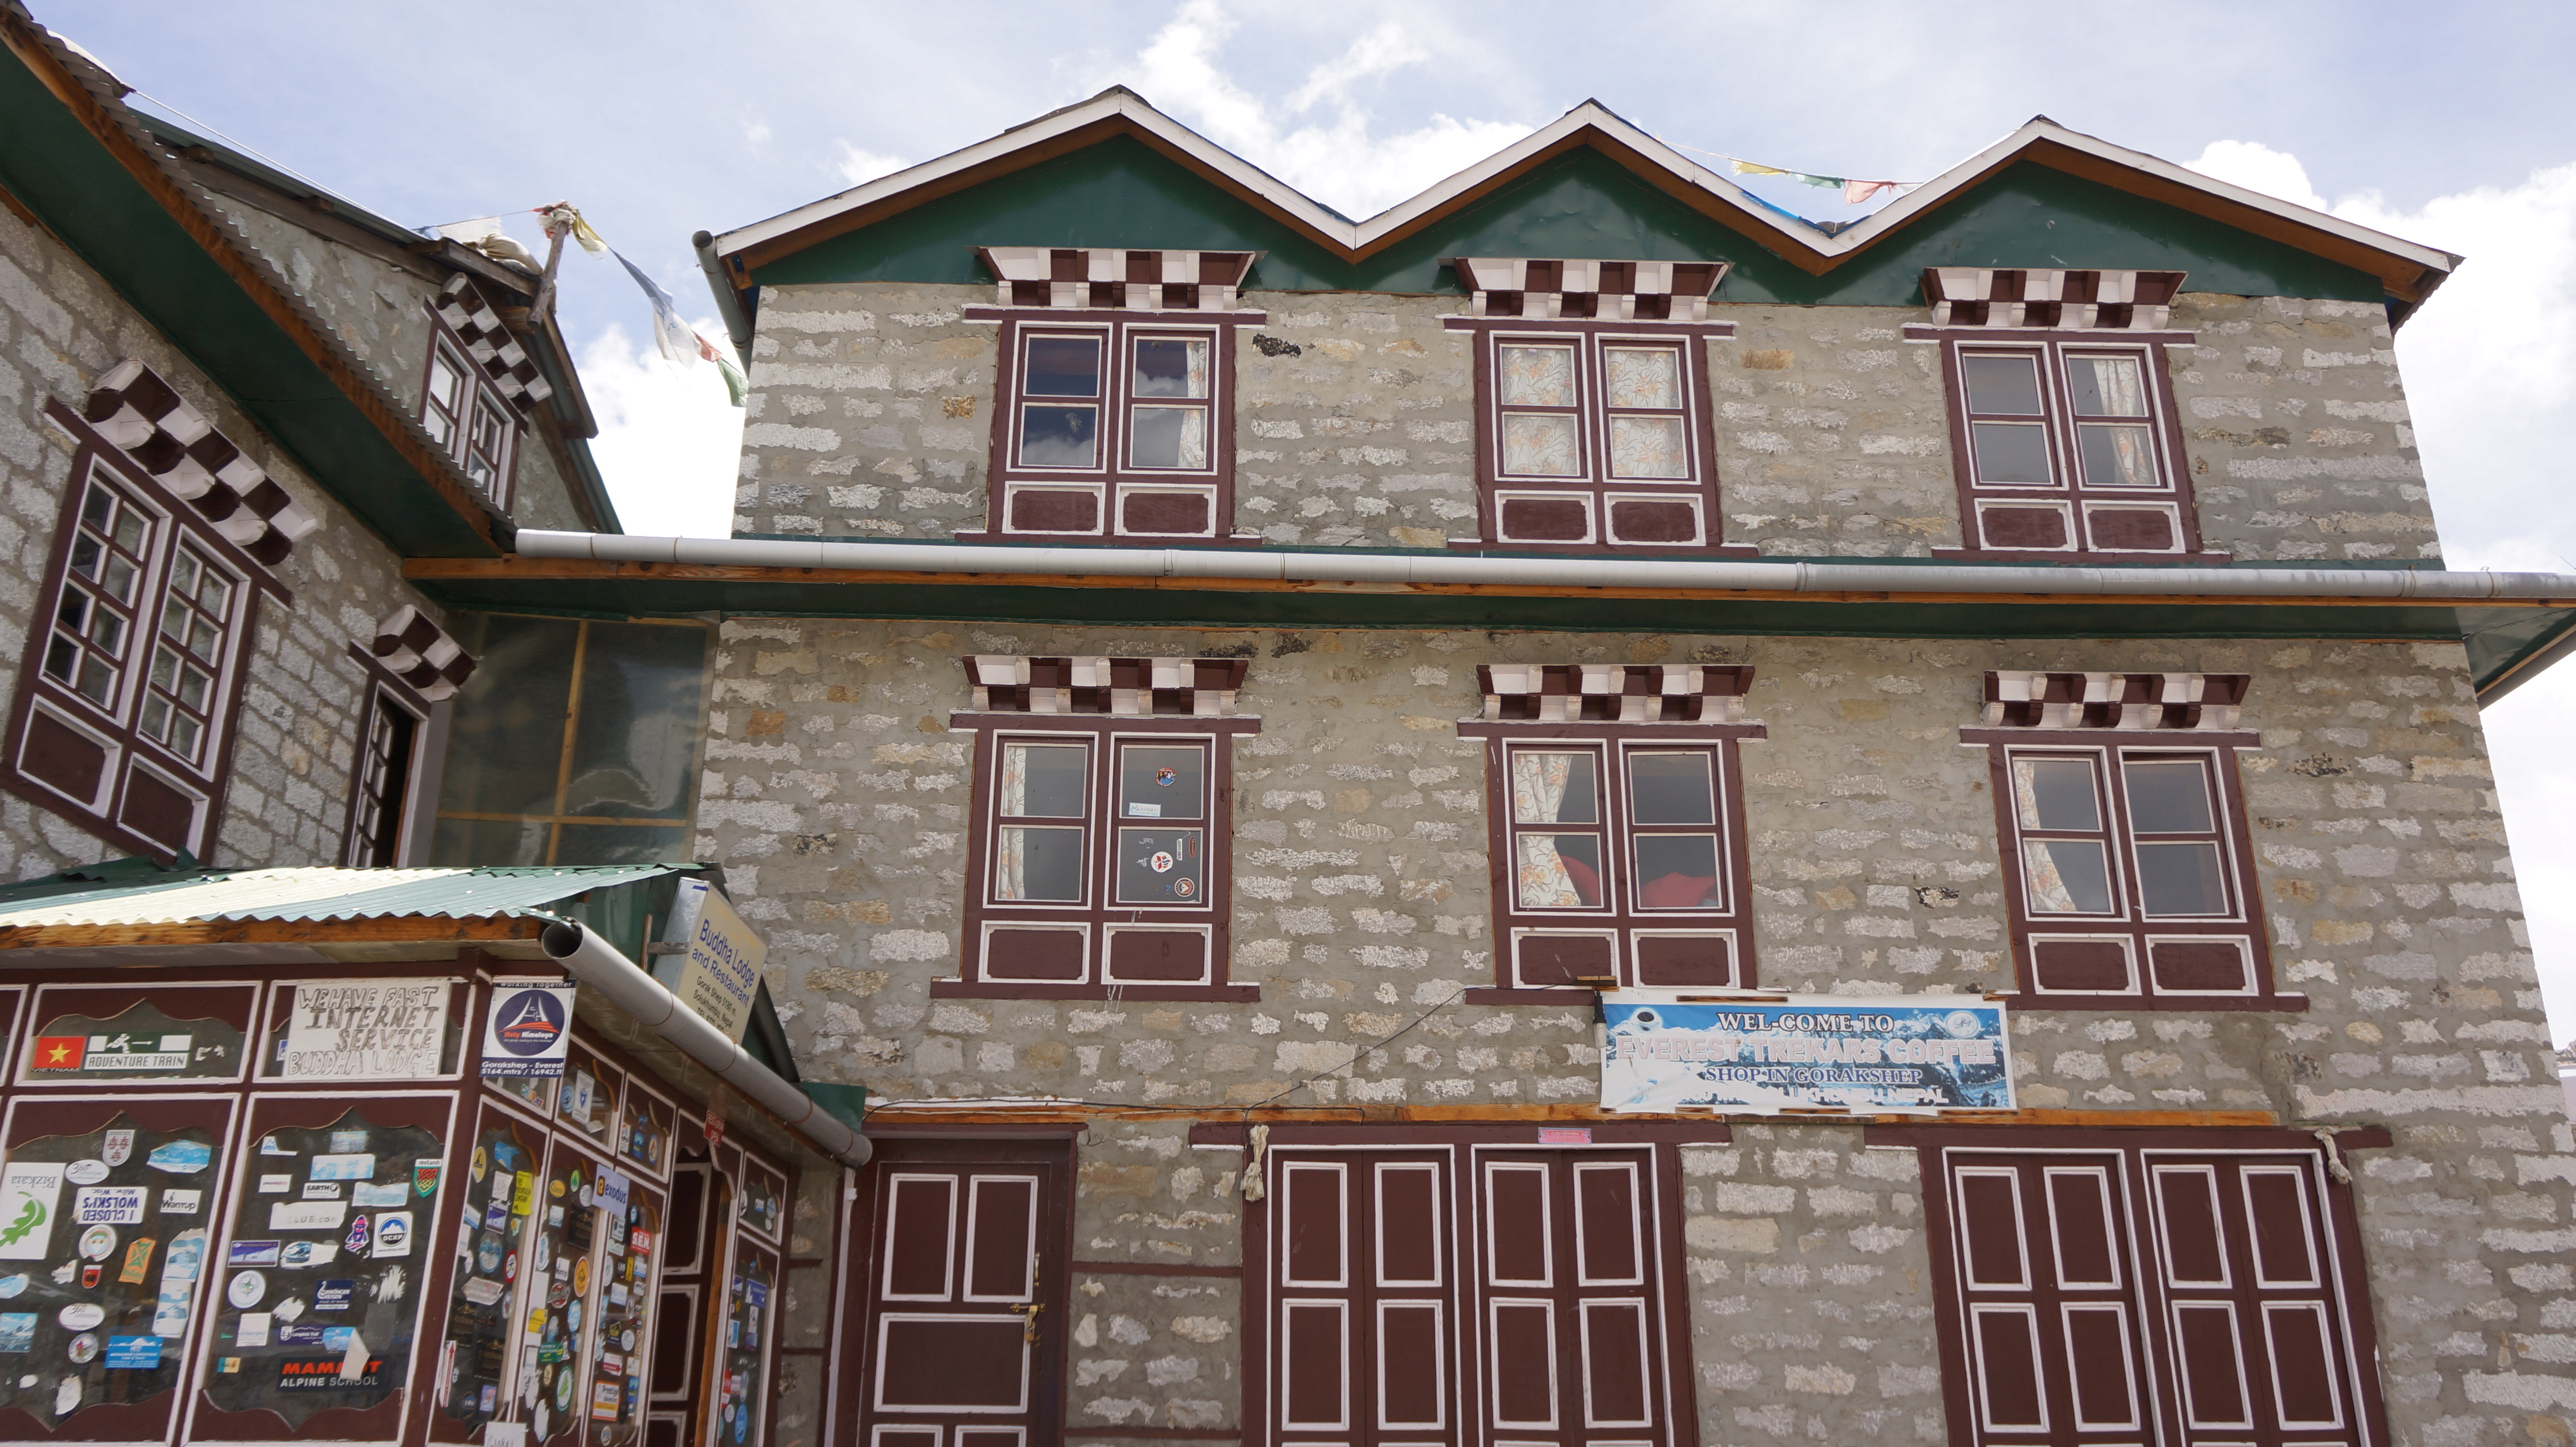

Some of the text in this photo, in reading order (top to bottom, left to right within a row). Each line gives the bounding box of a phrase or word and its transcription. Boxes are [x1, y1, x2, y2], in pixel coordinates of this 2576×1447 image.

[699, 919, 732, 968] Buddha
[732, 949, 755, 988] Lodge
[692, 948, 750, 1008] and Restaurant
[298, 986, 439, 1009] WE HAVE FAST
[697, 976, 711, 992] Gorak
[711, 988, 722, 1004] Shep
[304, 1006, 439, 1030] INTERNET
[721, 1013, 734, 1029] Nepal
[1716, 1012, 1894, 1032] WEL-COME TO
[334, 1027, 437, 1052] SERVICE
[521, 1031, 553, 1039] Himalaya
[1616, 1036, 1995, 1064] EVEREST TREKARS COFFEE
[88, 1055, 185, 1067] ADVENTURE TRAIN
[289, 1049, 439, 1078] BUDDHA LODGE
[481, 1061, 528, 1070] Gorakshep
[1705, 1067, 1923, 1084] SHOP IN GORAKSHEP
[1887, 1088, 1949, 1103] NEPAL
[10, 1175, 58, 1189] Bizkaia
[604, 1183, 627, 1205] exodus
[82, 1197, 138, 1209] WOLSKI'S
[162, 1200, 196, 1210] Warmup
[82, 1210, 133, 1221] I CLOSED
[281, 1361, 383, 1375] MAMT
[280, 1376, 379, 1387] ALPINE SCHOOL
